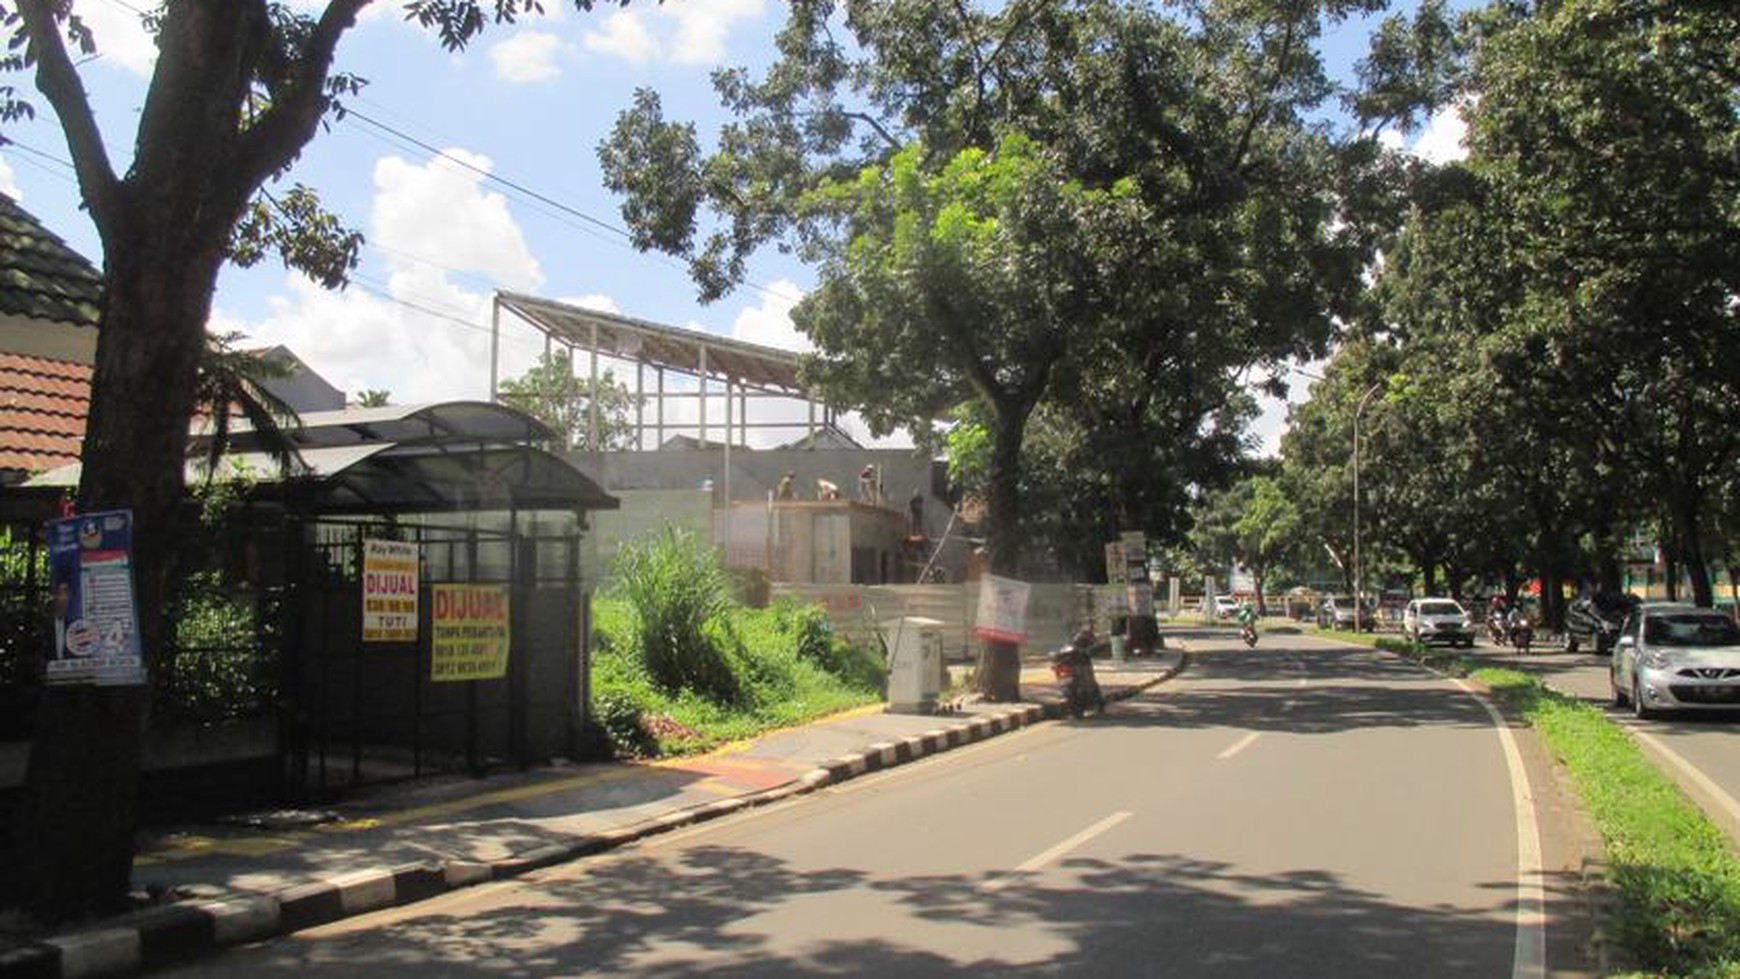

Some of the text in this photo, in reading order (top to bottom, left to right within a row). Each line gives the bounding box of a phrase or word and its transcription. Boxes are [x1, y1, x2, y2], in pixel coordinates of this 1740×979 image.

[366, 573, 415, 594] DIJUAL
[436, 590, 505, 620] DIJUAL
[378, 616, 407, 627] TUTI
